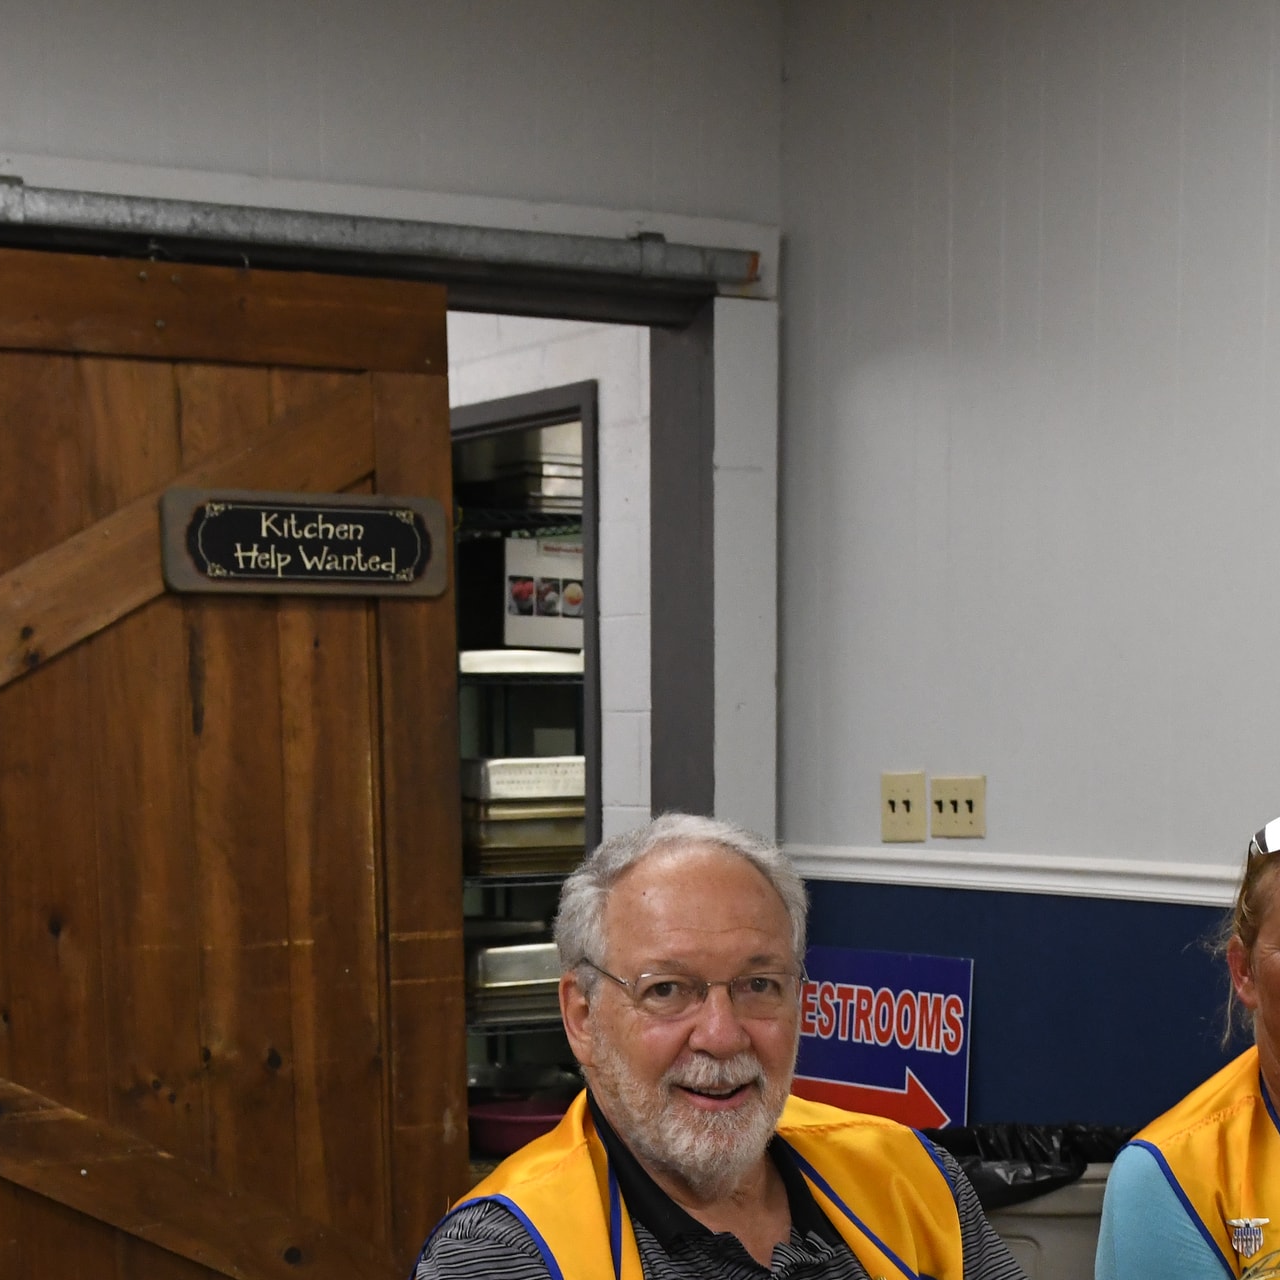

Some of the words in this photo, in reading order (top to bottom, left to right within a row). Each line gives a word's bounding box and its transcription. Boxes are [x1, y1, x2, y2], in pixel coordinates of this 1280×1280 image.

[261, 512, 364, 540] Kitchen
[234, 543, 291, 578] Help
[299, 545, 397, 574] Wanted
[800, 981, 964, 1055] ESTROOMS
